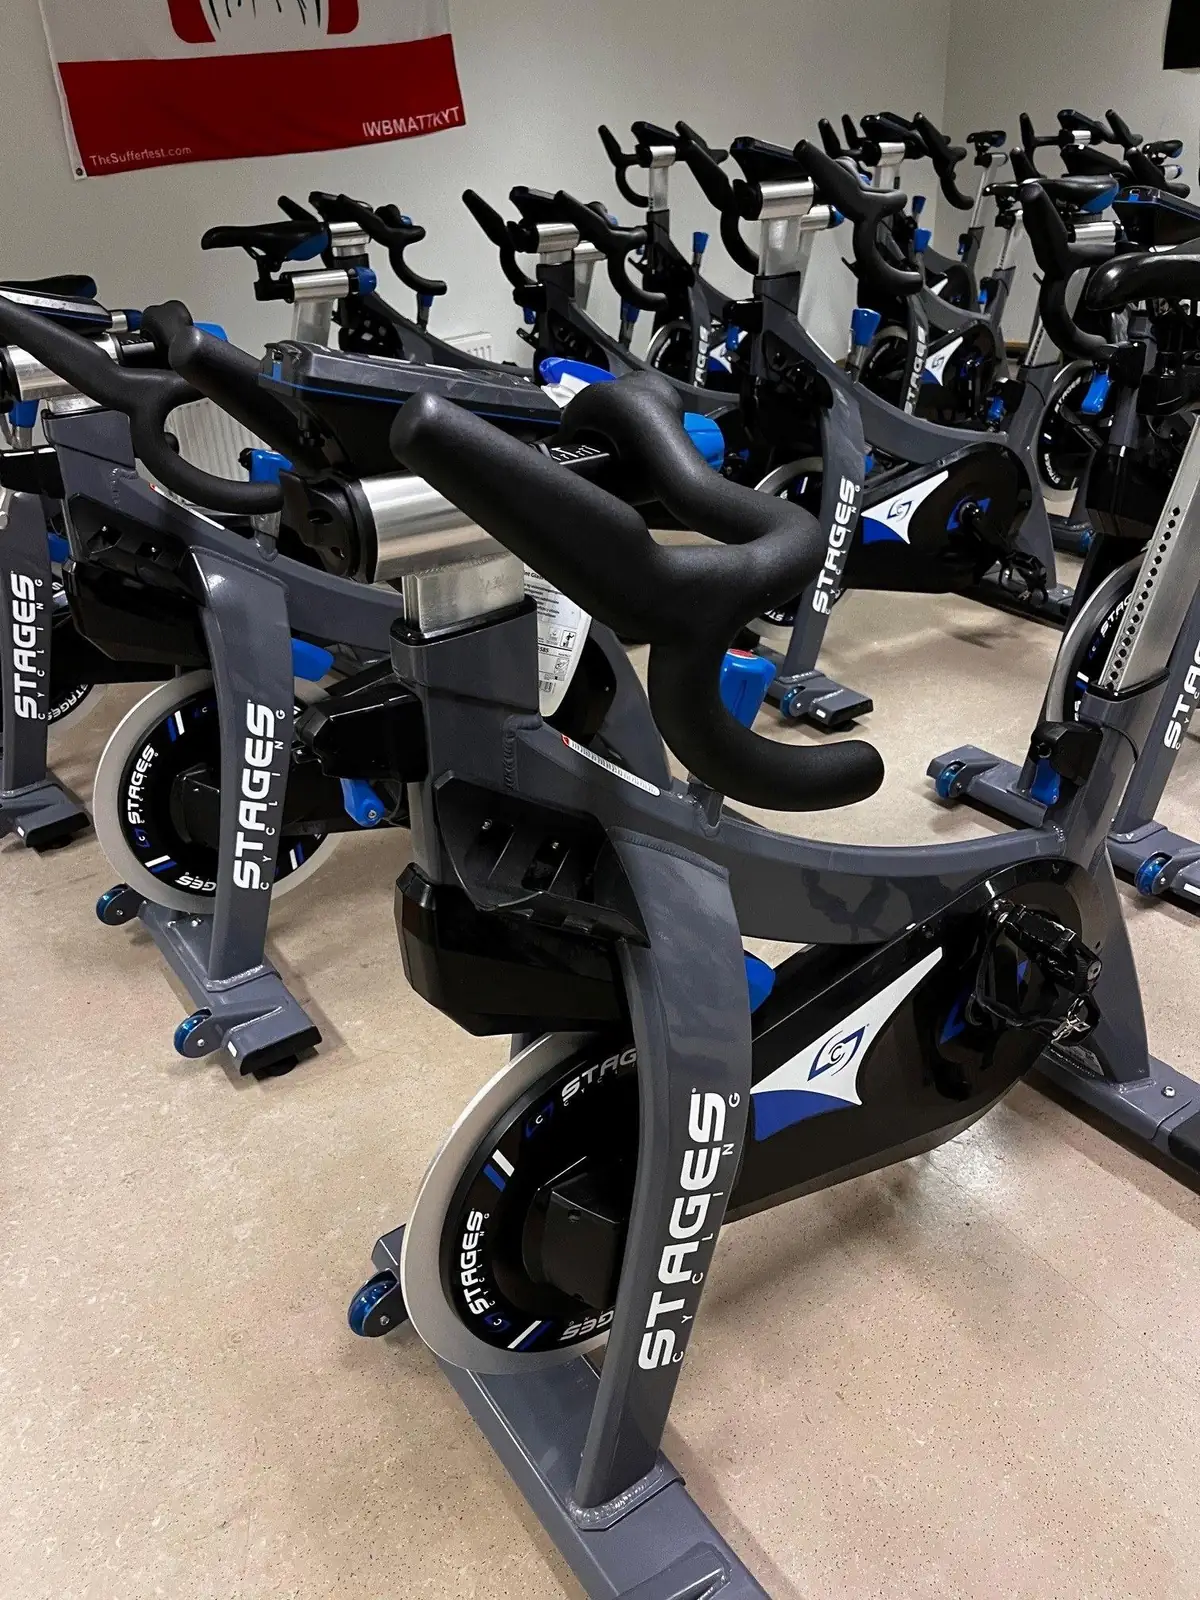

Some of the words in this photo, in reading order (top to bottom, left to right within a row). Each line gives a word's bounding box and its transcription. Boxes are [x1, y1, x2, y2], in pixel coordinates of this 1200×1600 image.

[812, 476, 855, 614] STAGES
[10, 571, 38, 719] STAGES
[34, 579, 46, 720] CYCLING
[127, 743, 155, 825] STAGES
[233, 700, 275, 890] STAGES
[258, 710, 286, 890] CYCLING
[562, 1048, 637, 1102] STAG
[461, 1209, 490, 1315] STAGES
[638, 1088, 727, 1370] STAGES
[672, 1092, 741, 1363] CYCLING
